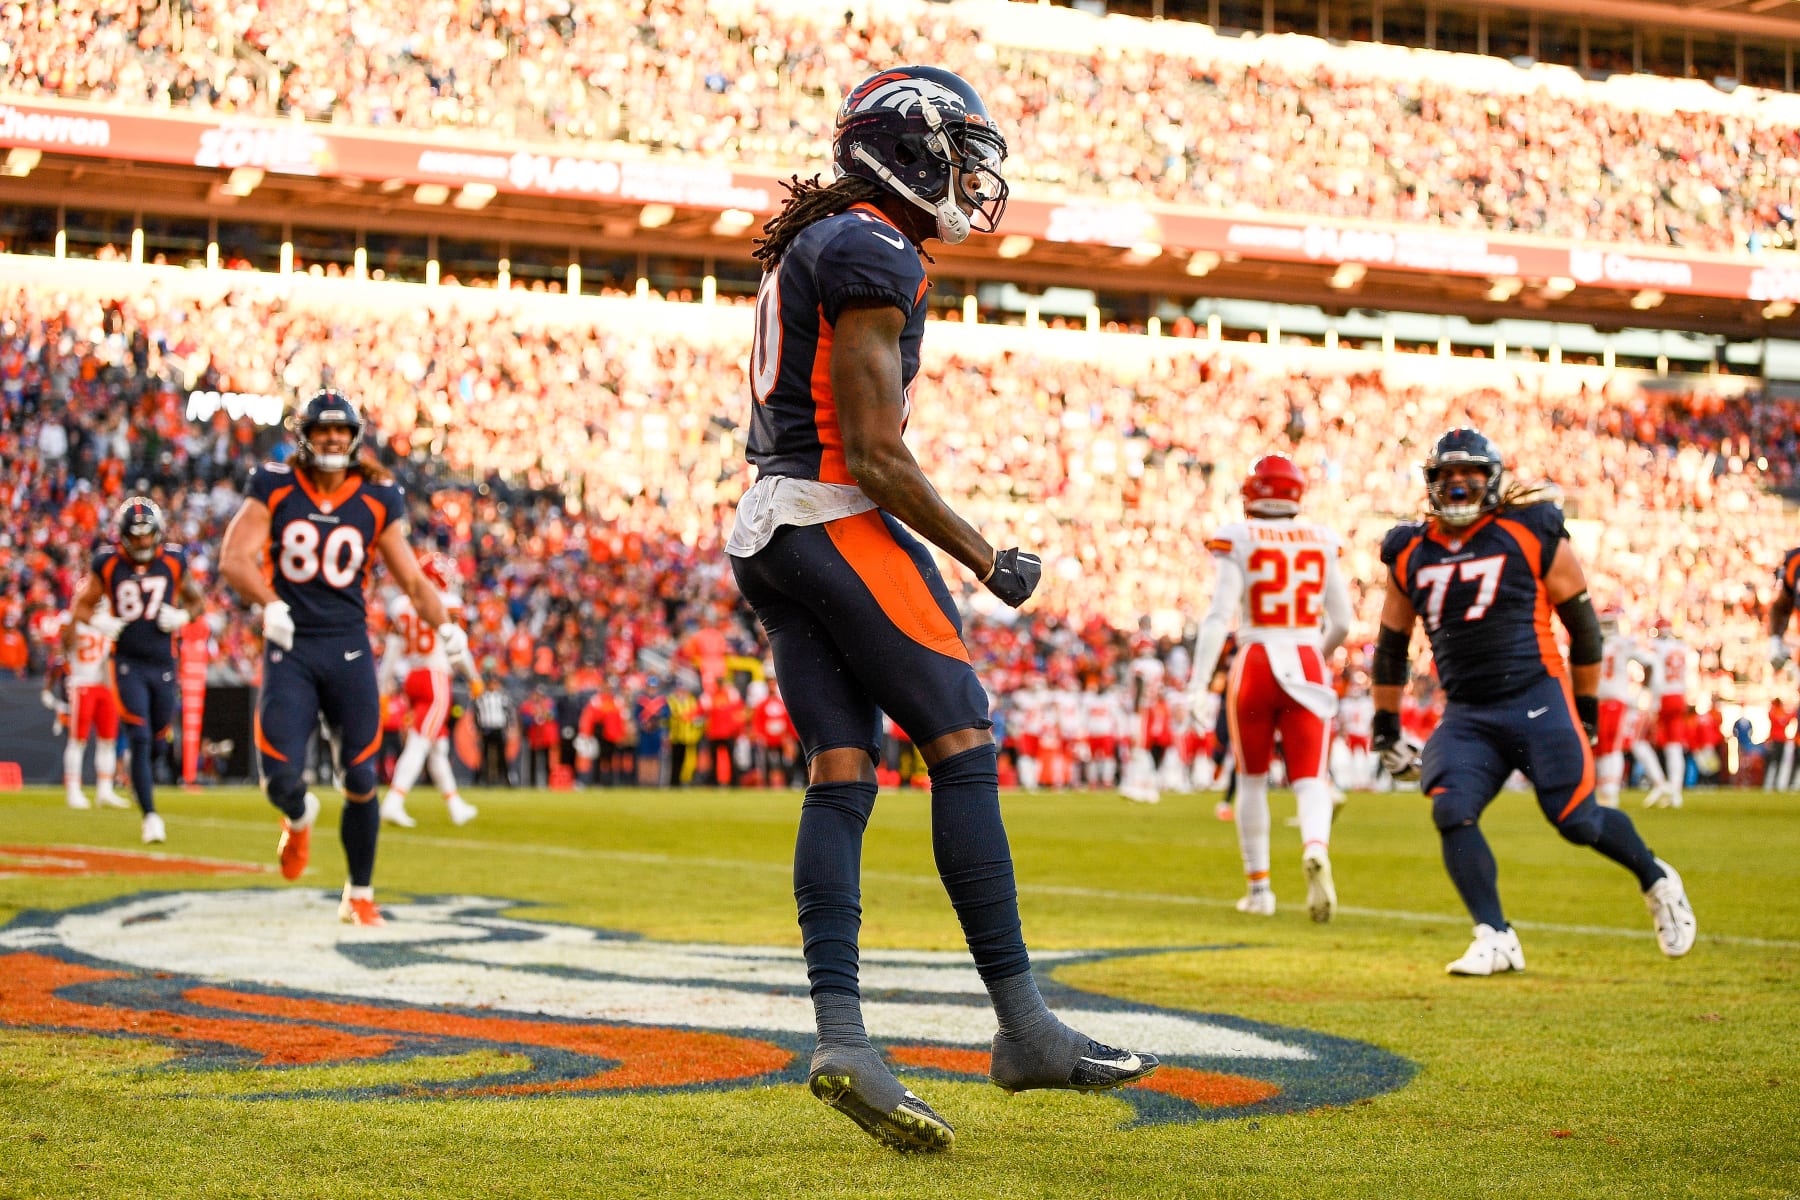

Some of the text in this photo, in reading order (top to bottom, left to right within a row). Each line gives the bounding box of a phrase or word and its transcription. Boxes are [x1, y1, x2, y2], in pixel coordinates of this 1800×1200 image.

[280, 519, 365, 589] 80
[1247, 547, 1326, 628] 22
[116, 575, 168, 622] 87
[1415, 554, 1507, 633] 77
